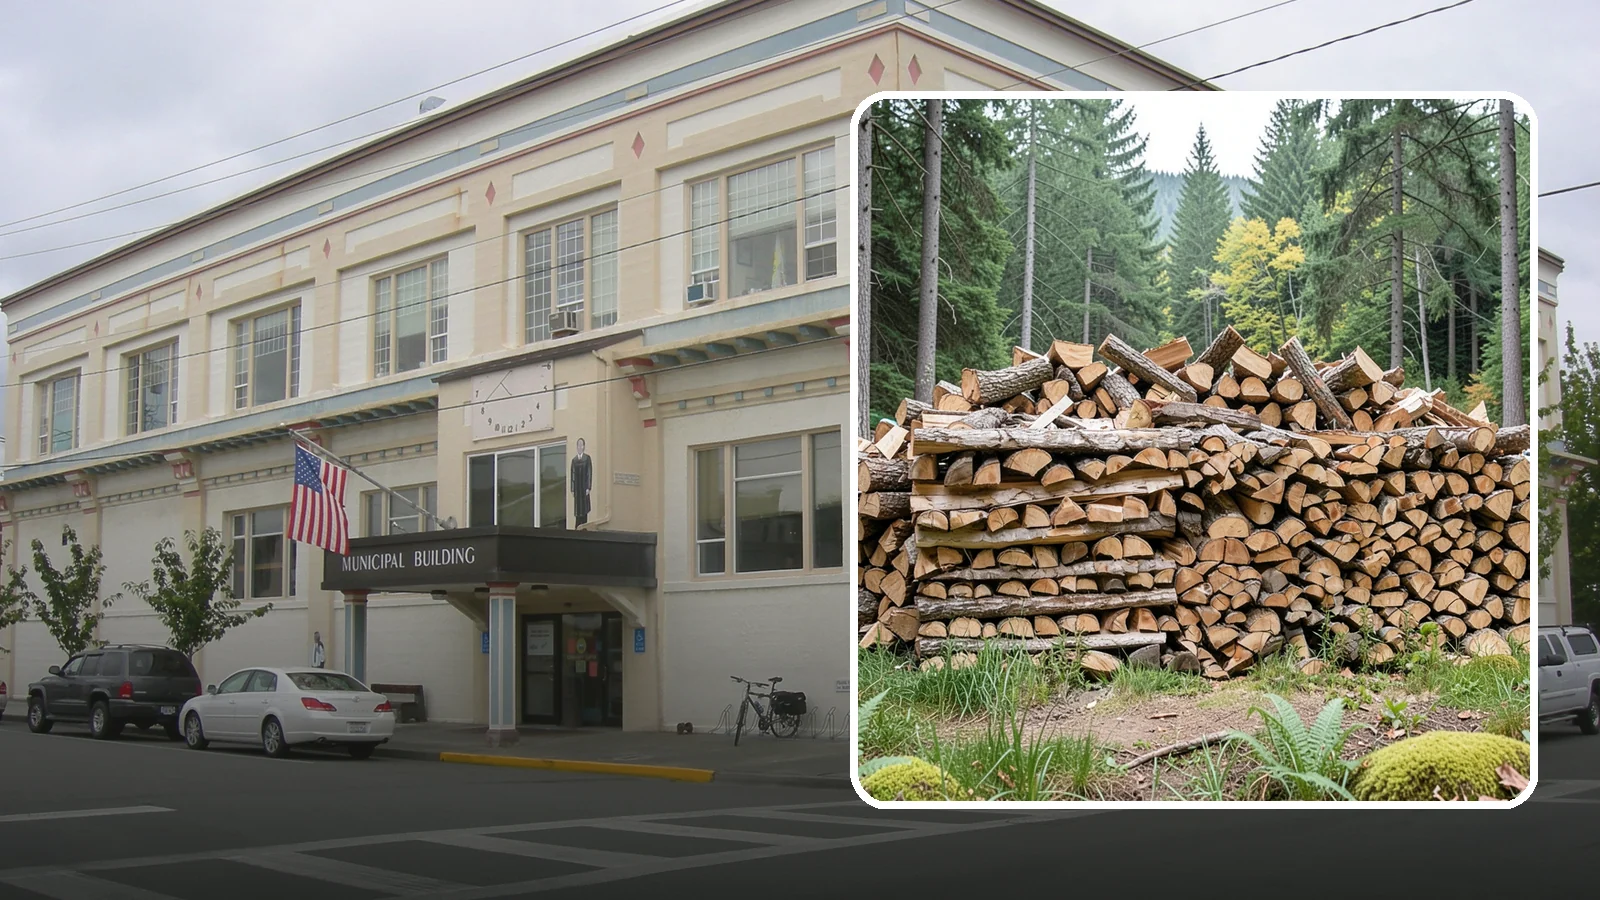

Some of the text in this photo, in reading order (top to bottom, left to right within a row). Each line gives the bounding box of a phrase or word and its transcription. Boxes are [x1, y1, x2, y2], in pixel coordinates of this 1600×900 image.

[475, 390, 479, 398] 7
[536, 402, 540, 410] 4
[480, 407, 485, 415] 8
[487, 418, 492, 426] 9
[528, 414, 533, 422] 3
[494, 424, 500, 432] 10
[521, 420, 525, 428] 2
[507, 425, 513, 433] 12
[342, 546, 475, 572] MUNICIPAL BUILDING
